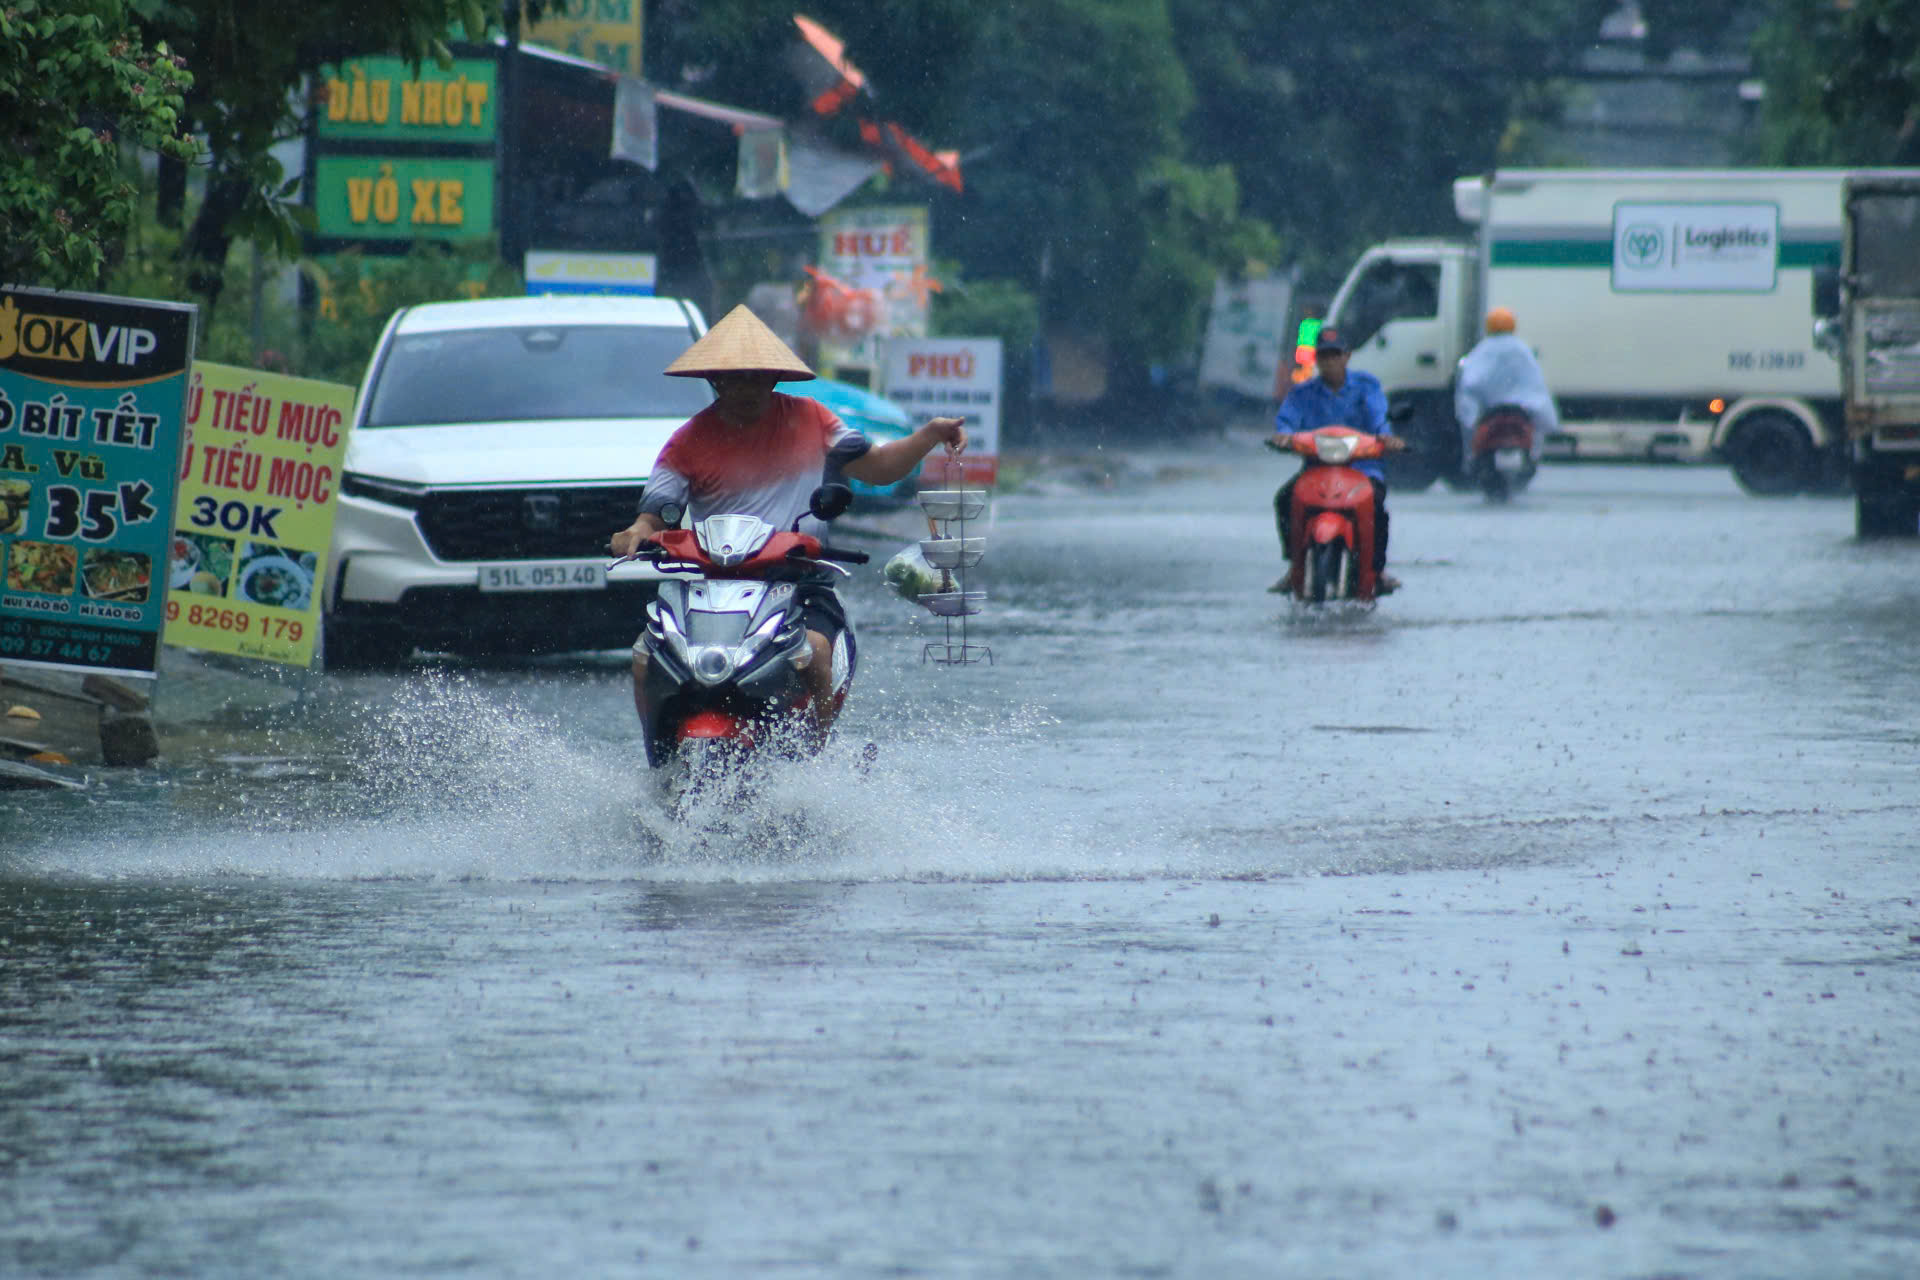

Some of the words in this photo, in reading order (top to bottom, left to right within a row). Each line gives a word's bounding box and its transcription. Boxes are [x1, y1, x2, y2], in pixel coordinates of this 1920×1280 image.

[347, 162, 399, 223] VỎ
[411, 180, 464, 225] XE
[1685, 226, 1769, 254] Logistics
[21, 393, 84, 440] BÍT
[93, 393, 159, 448] TẾT
[187, 373, 204, 425] Ủ
[211, 382, 272, 436] TIẾU
[276, 400, 342, 453] MỰC
[54, 450, 105, 480] Vũ
[202, 439, 262, 493] TIẾU
[266, 456, 332, 511] MỌC
[46, 482, 156, 540] 35K
[190, 495, 282, 540] 30K
[165, 600, 181, 622] 9
[187, 604, 250, 633] 8269
[259, 615, 304, 642] 179
